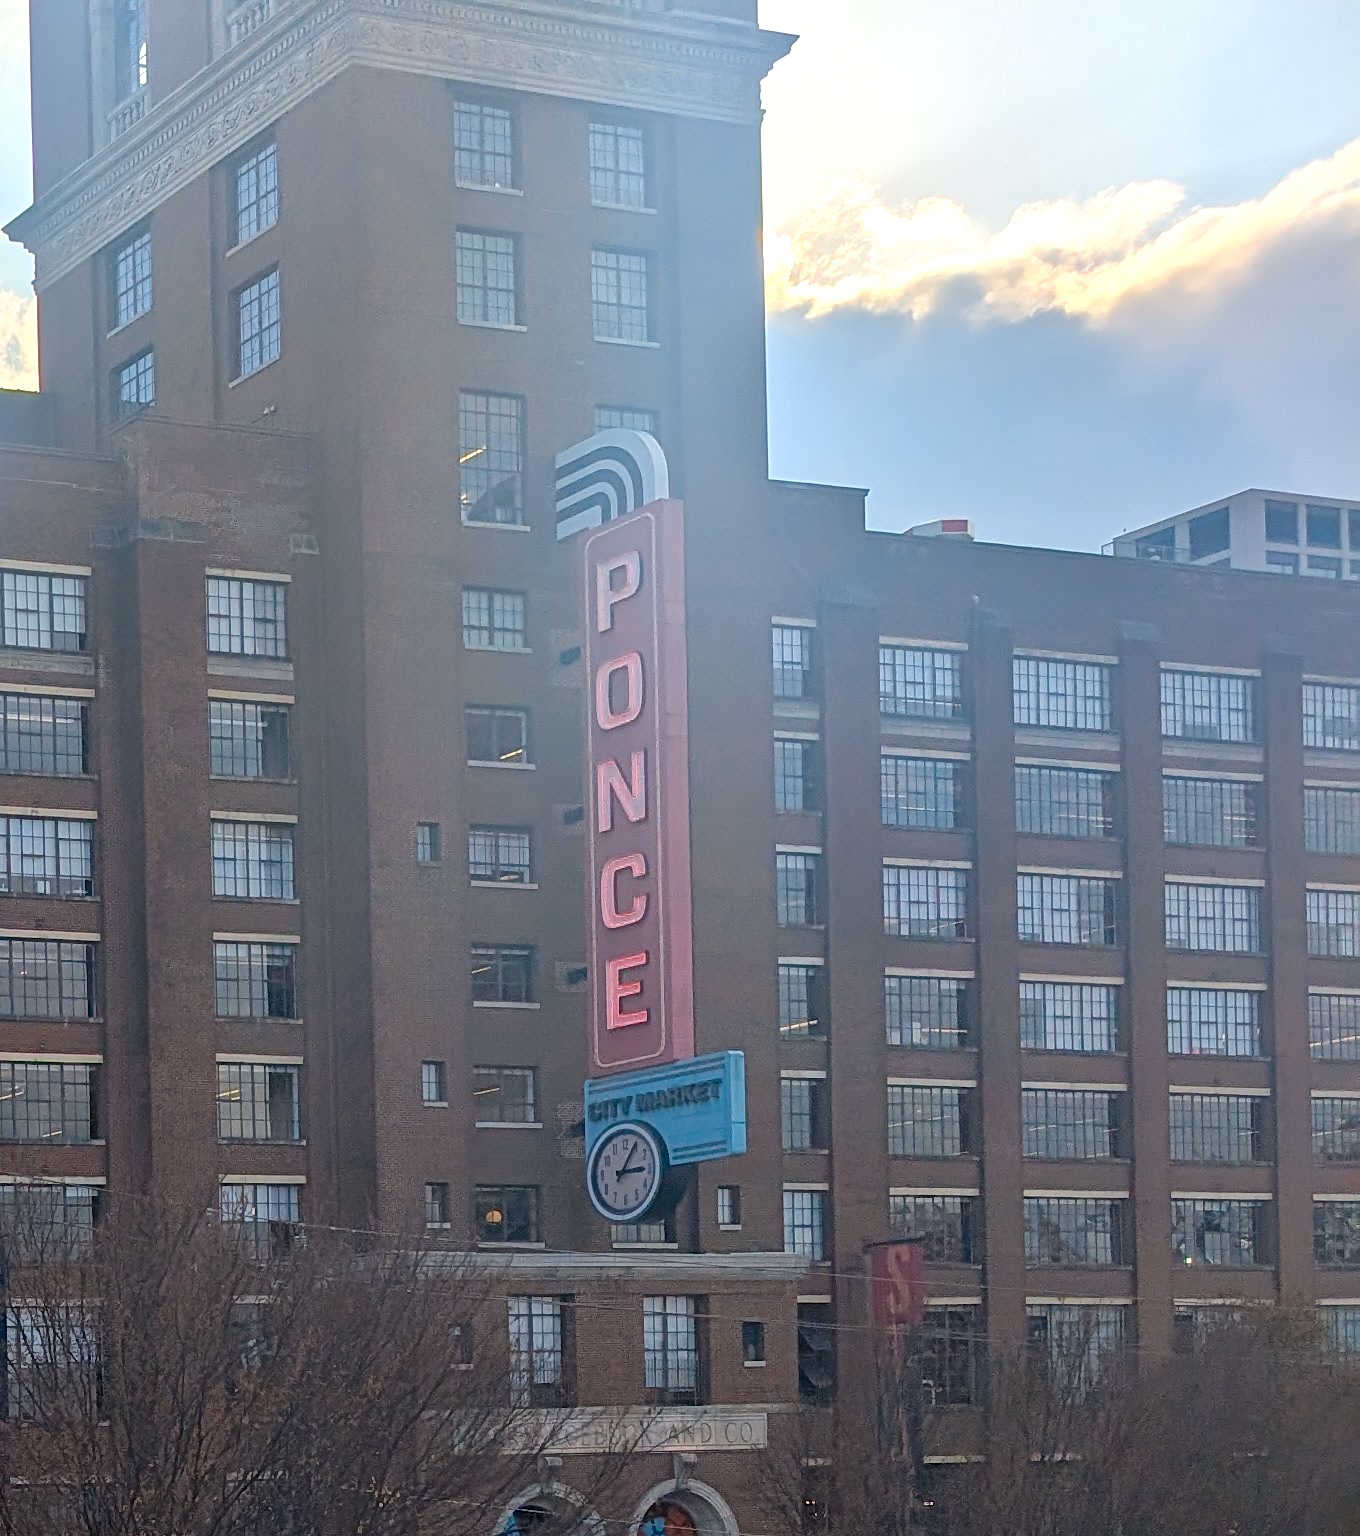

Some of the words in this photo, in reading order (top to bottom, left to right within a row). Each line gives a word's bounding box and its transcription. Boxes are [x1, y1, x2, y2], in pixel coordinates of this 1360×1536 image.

[596, 549, 648, 1032] PONCE
[588, 1096, 633, 1121] CITY
[635, 1078, 723, 1113] MARKET
[669, 1421, 712, 1444] AND
